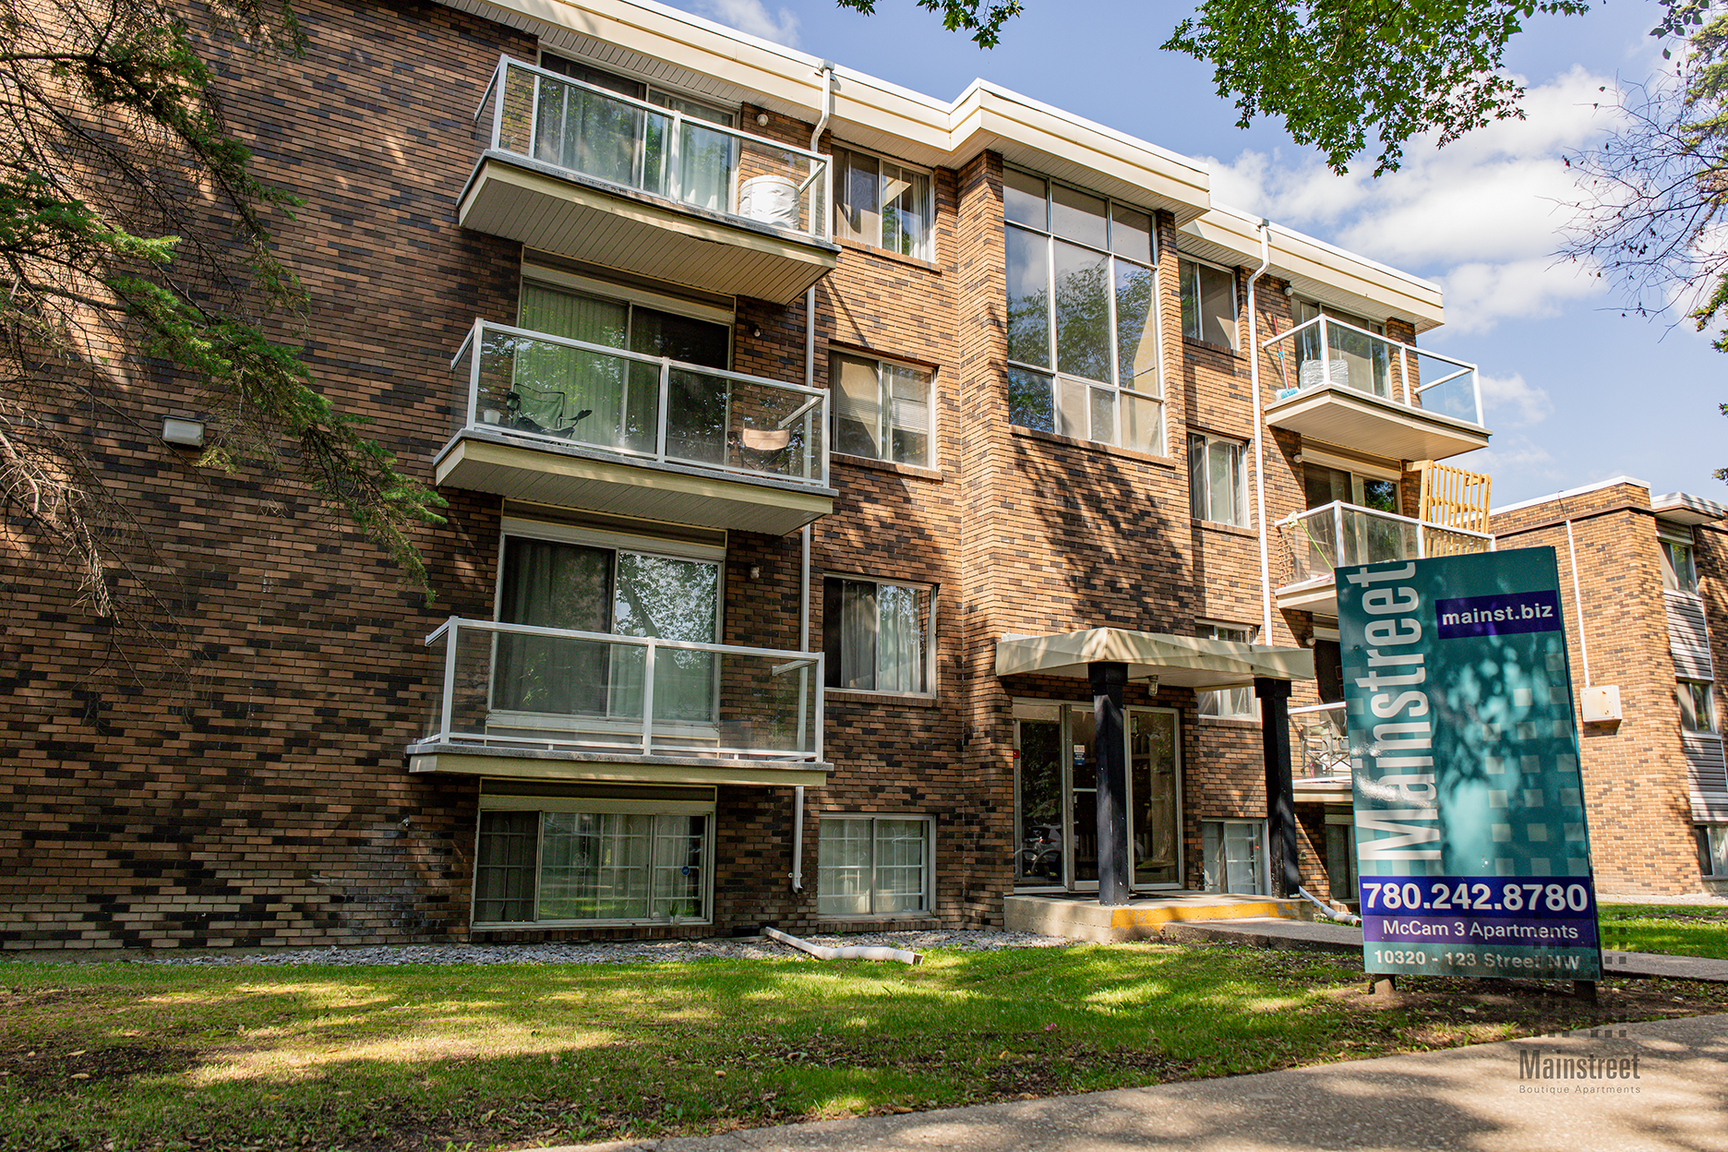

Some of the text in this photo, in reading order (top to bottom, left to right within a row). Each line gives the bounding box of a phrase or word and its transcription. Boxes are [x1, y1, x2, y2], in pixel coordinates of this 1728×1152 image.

[1442, 602, 1554, 626] mainst.biz
[1346, 561, 1442, 861] Mainstreet
[1362, 882, 1589, 912] 780.242.8780
[1383, 919, 1579, 939] McCam 3 Apartments
[1374, 949, 1426, 966] 10320
[1445, 952, 1477, 967] 123
[1484, 953, 1541, 969] Street
[1547, 955, 1581, 971] NW
